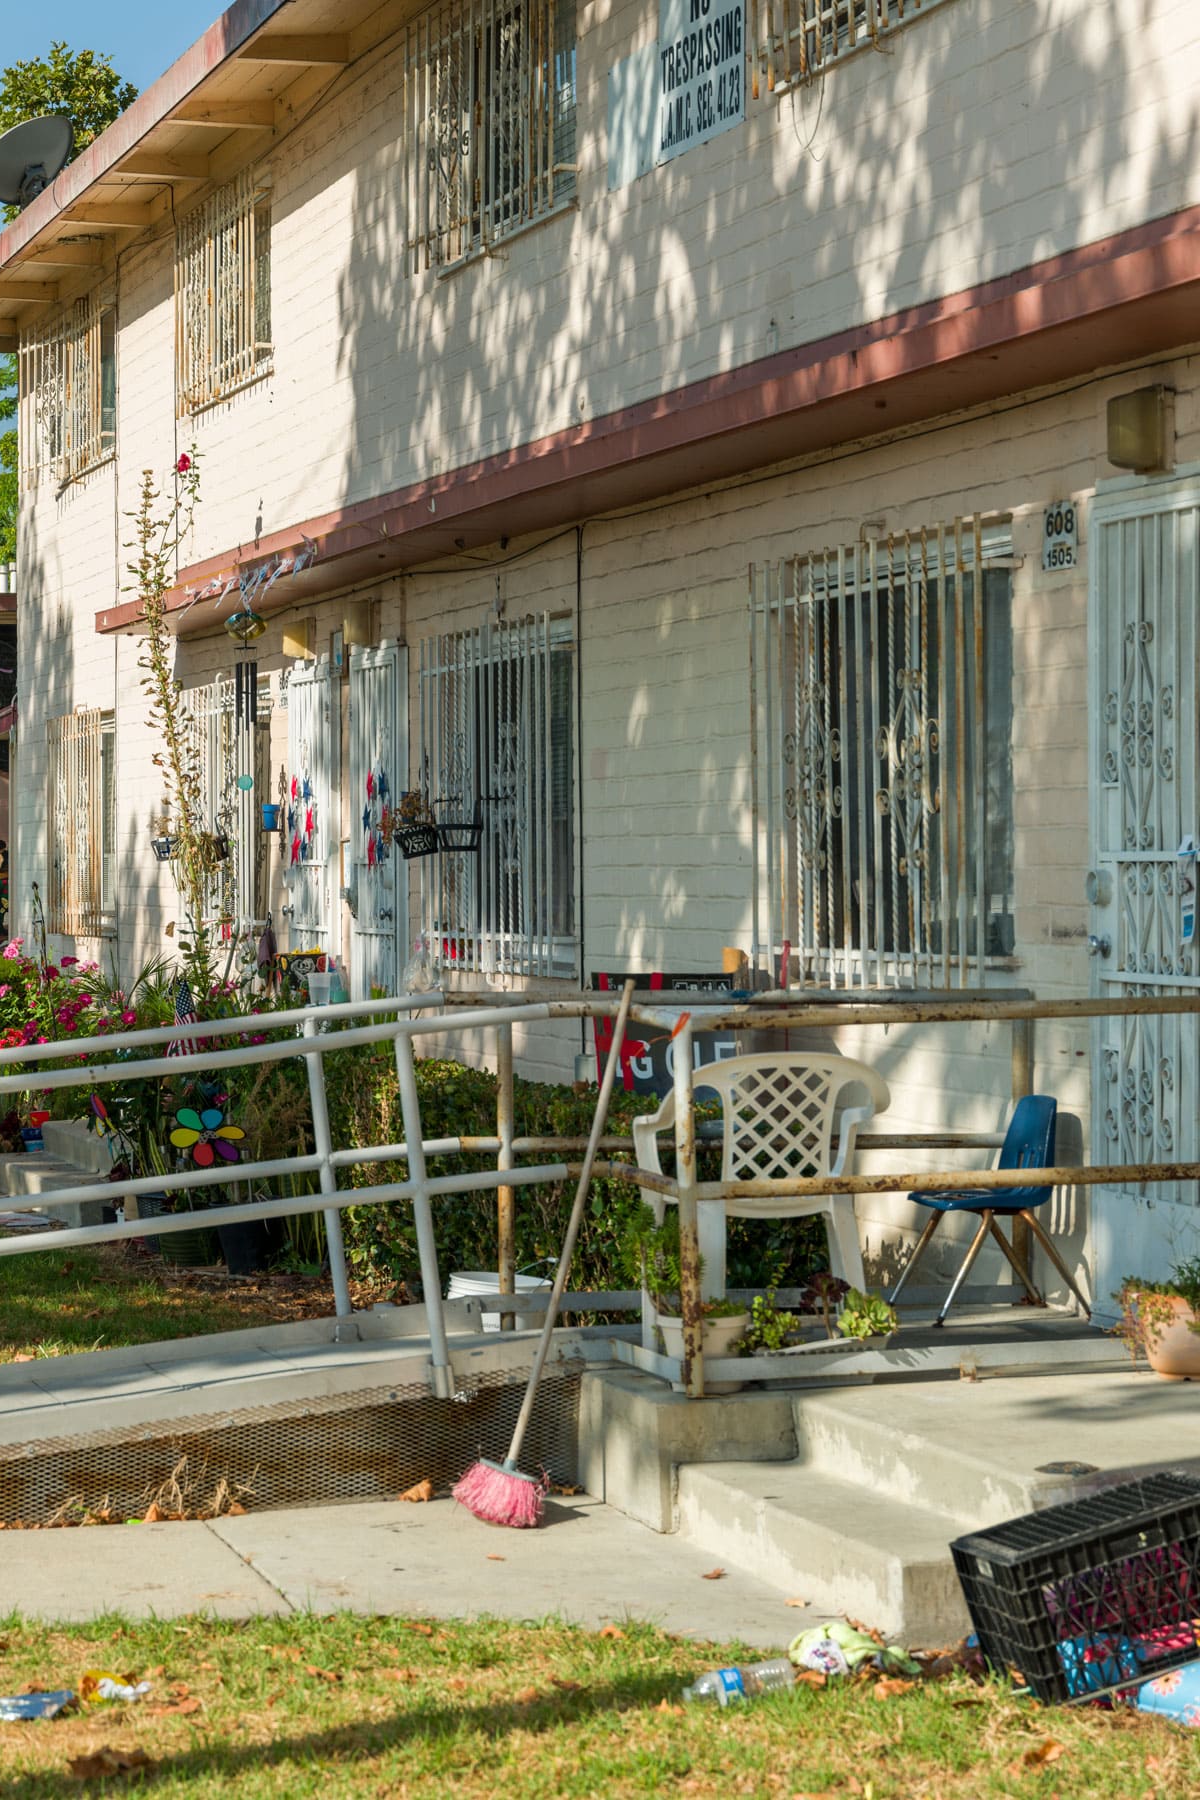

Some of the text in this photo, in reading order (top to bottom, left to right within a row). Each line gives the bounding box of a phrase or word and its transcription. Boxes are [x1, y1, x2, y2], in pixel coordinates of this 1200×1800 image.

[661, 5, 741, 95] TRESPASSING
[661, 64, 740, 151] L.A.M.C. SEC. 41.23
[1046, 508, 1074, 538] 608
[1047, 546, 1073, 568] 1505
